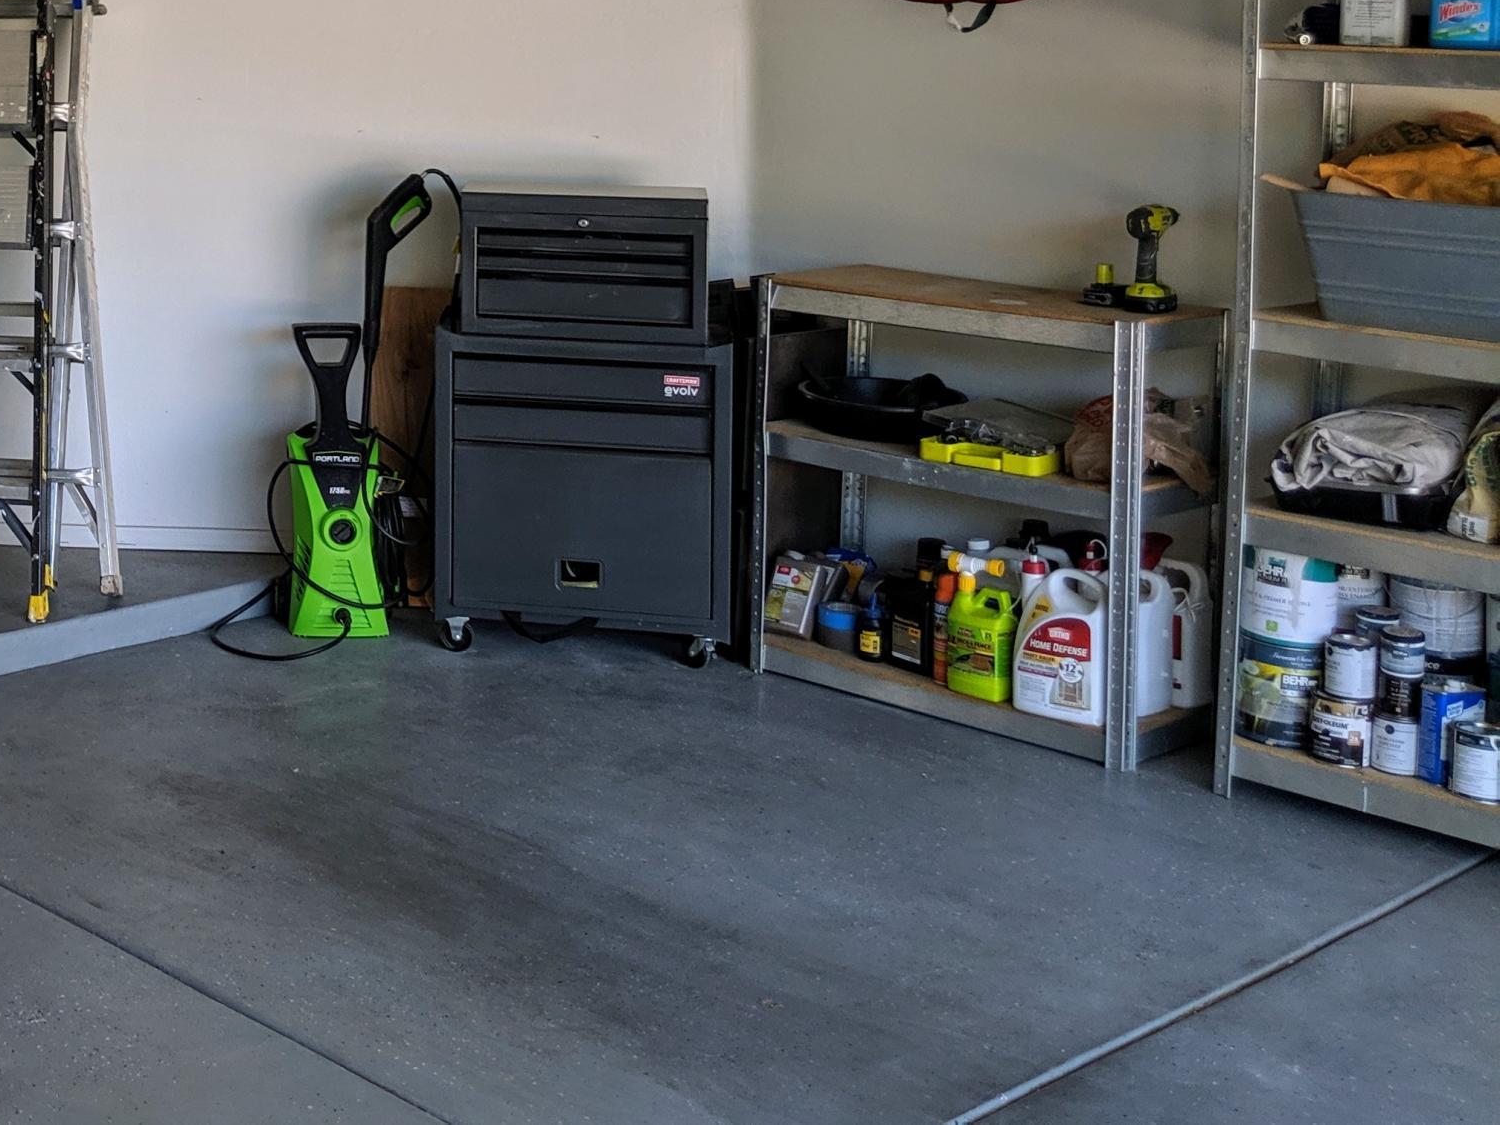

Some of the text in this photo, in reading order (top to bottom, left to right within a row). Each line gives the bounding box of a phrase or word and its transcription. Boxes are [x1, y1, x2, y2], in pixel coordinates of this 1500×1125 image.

[1439, 1, 1480, 22] Windex
[664, 385, 699, 397] evolv
[315, 455, 360, 463] PORTLAND
[1030, 638, 1088, 657] HOME DEFENSE
[1065, 663, 1076, 673] 12
[1282, 675, 1309, 686] BEHR
